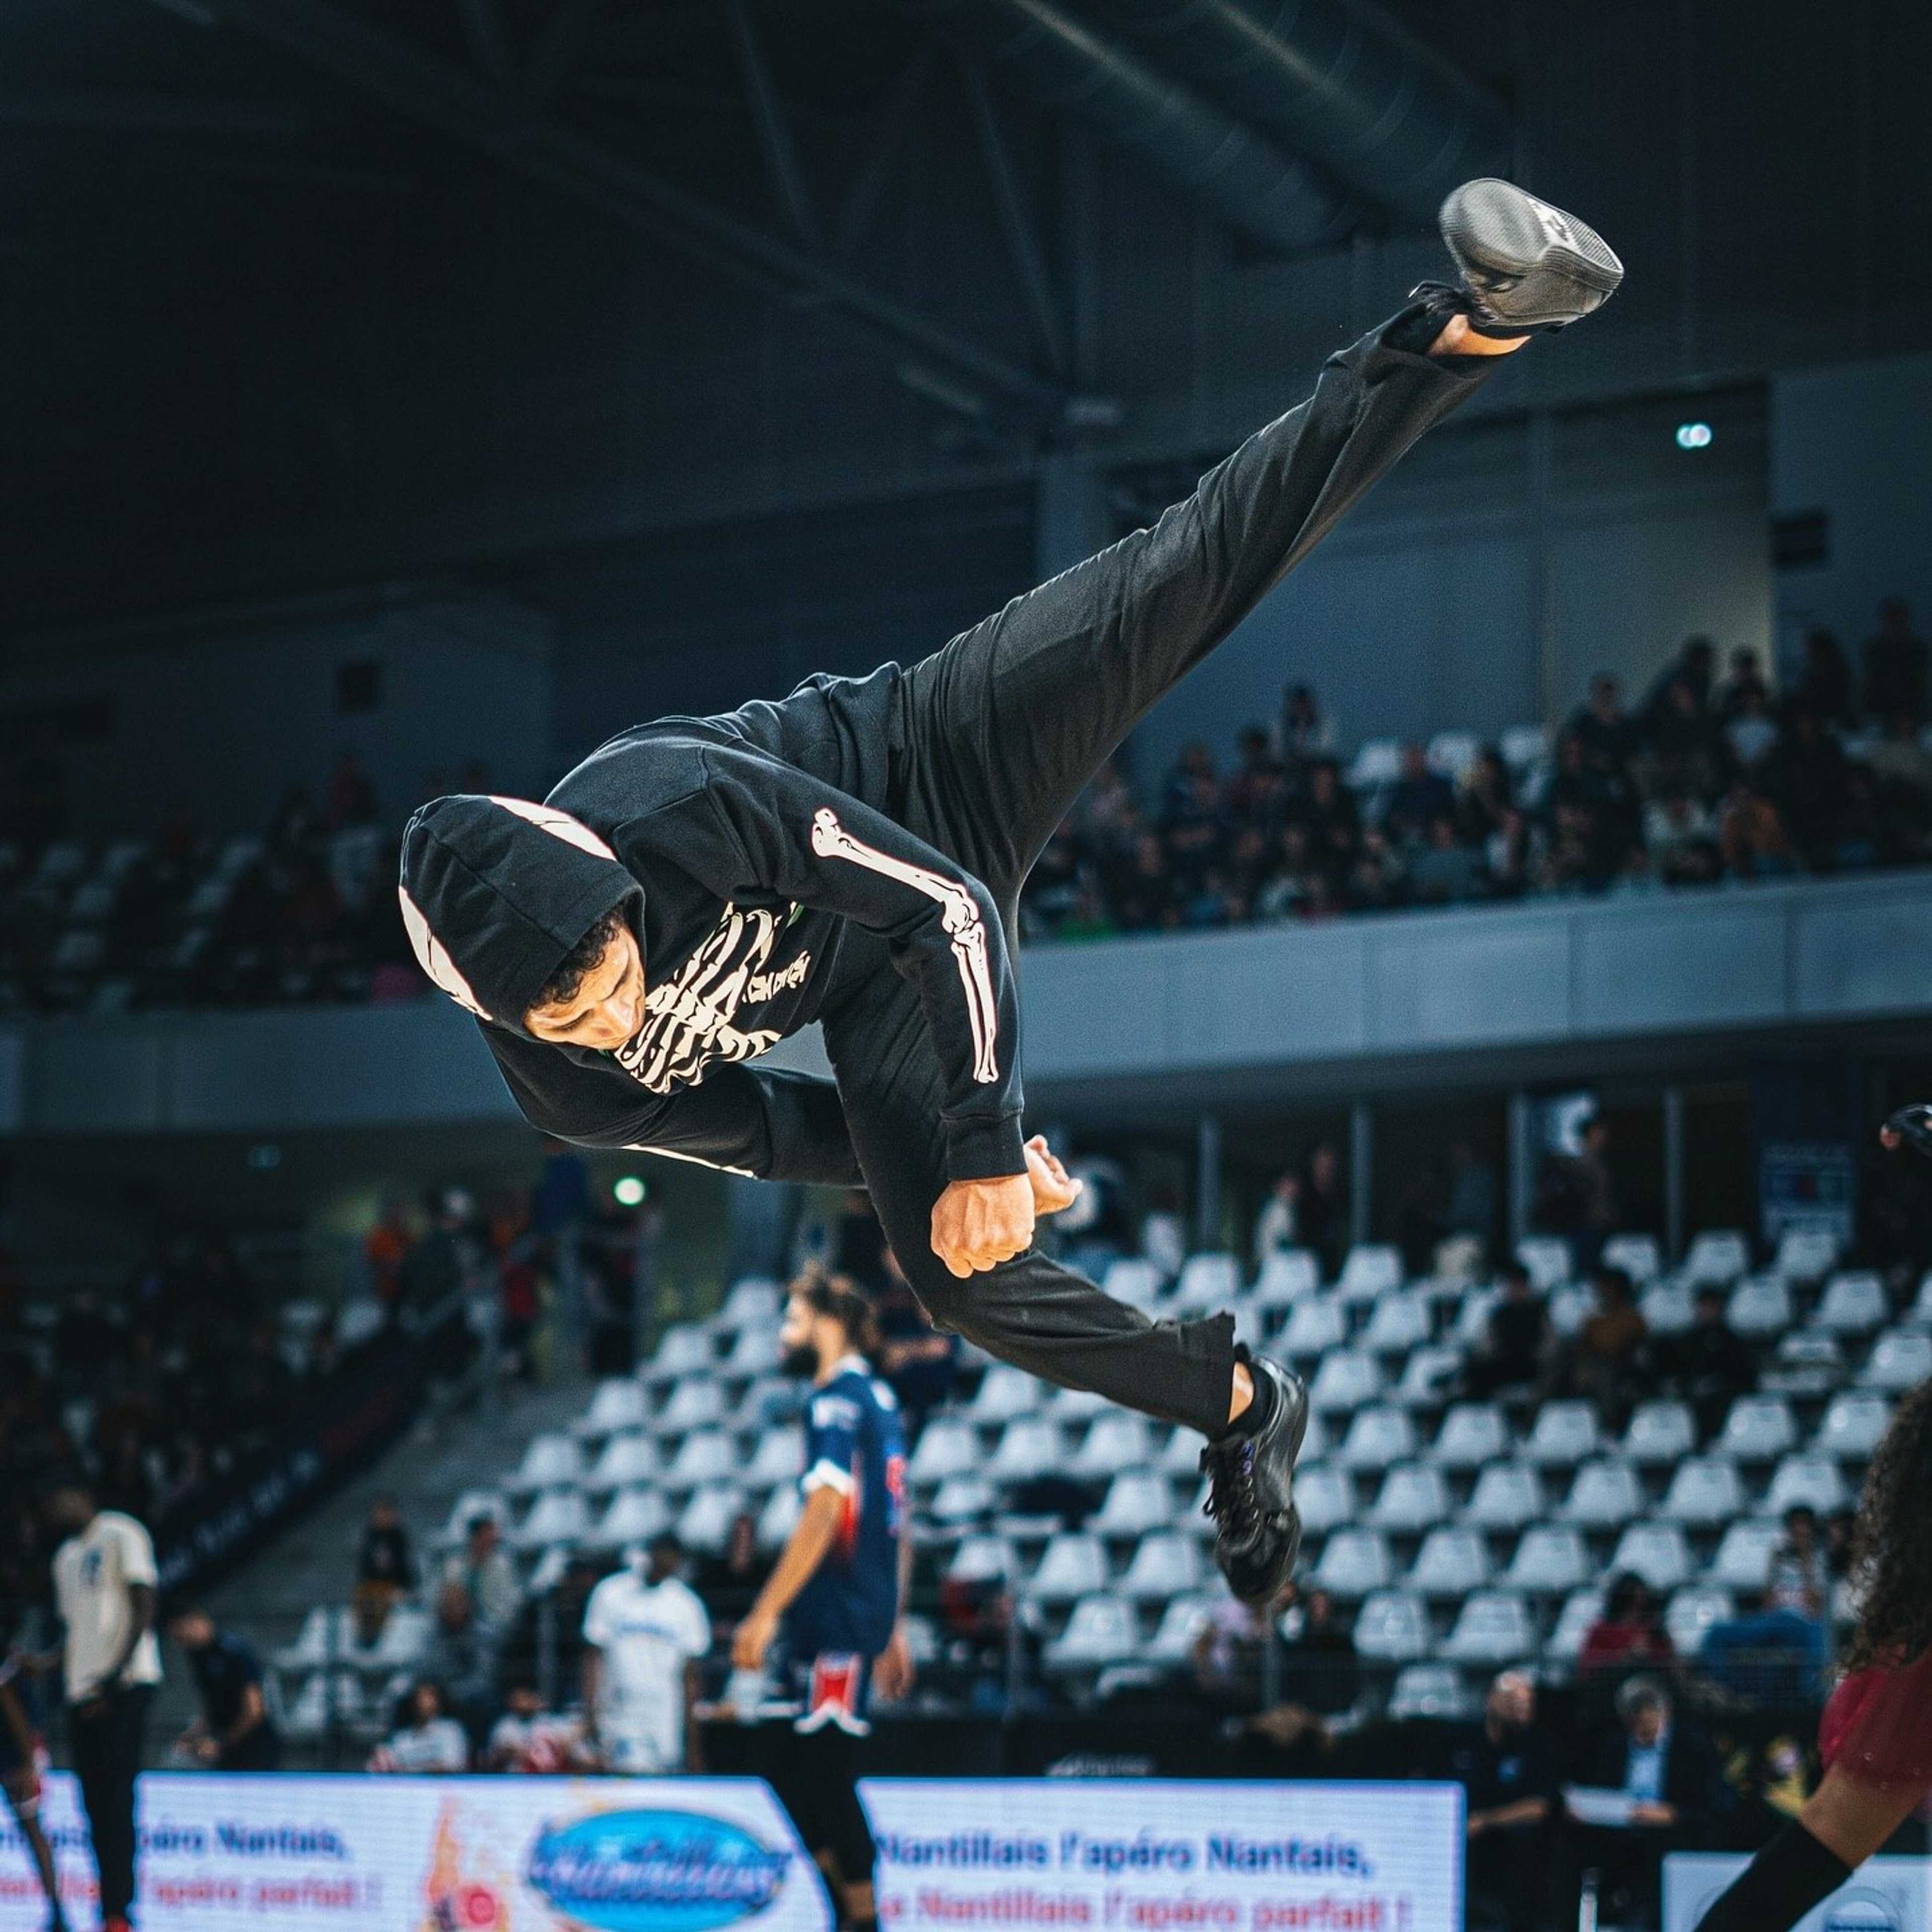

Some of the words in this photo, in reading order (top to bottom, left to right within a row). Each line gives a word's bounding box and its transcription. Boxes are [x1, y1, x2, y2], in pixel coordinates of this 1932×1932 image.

[874, 1831, 1048, 1869] Nantillais
[1059, 1827, 1193, 1876] l'apéro
[1206, 1830, 1376, 1881] Nantais,
